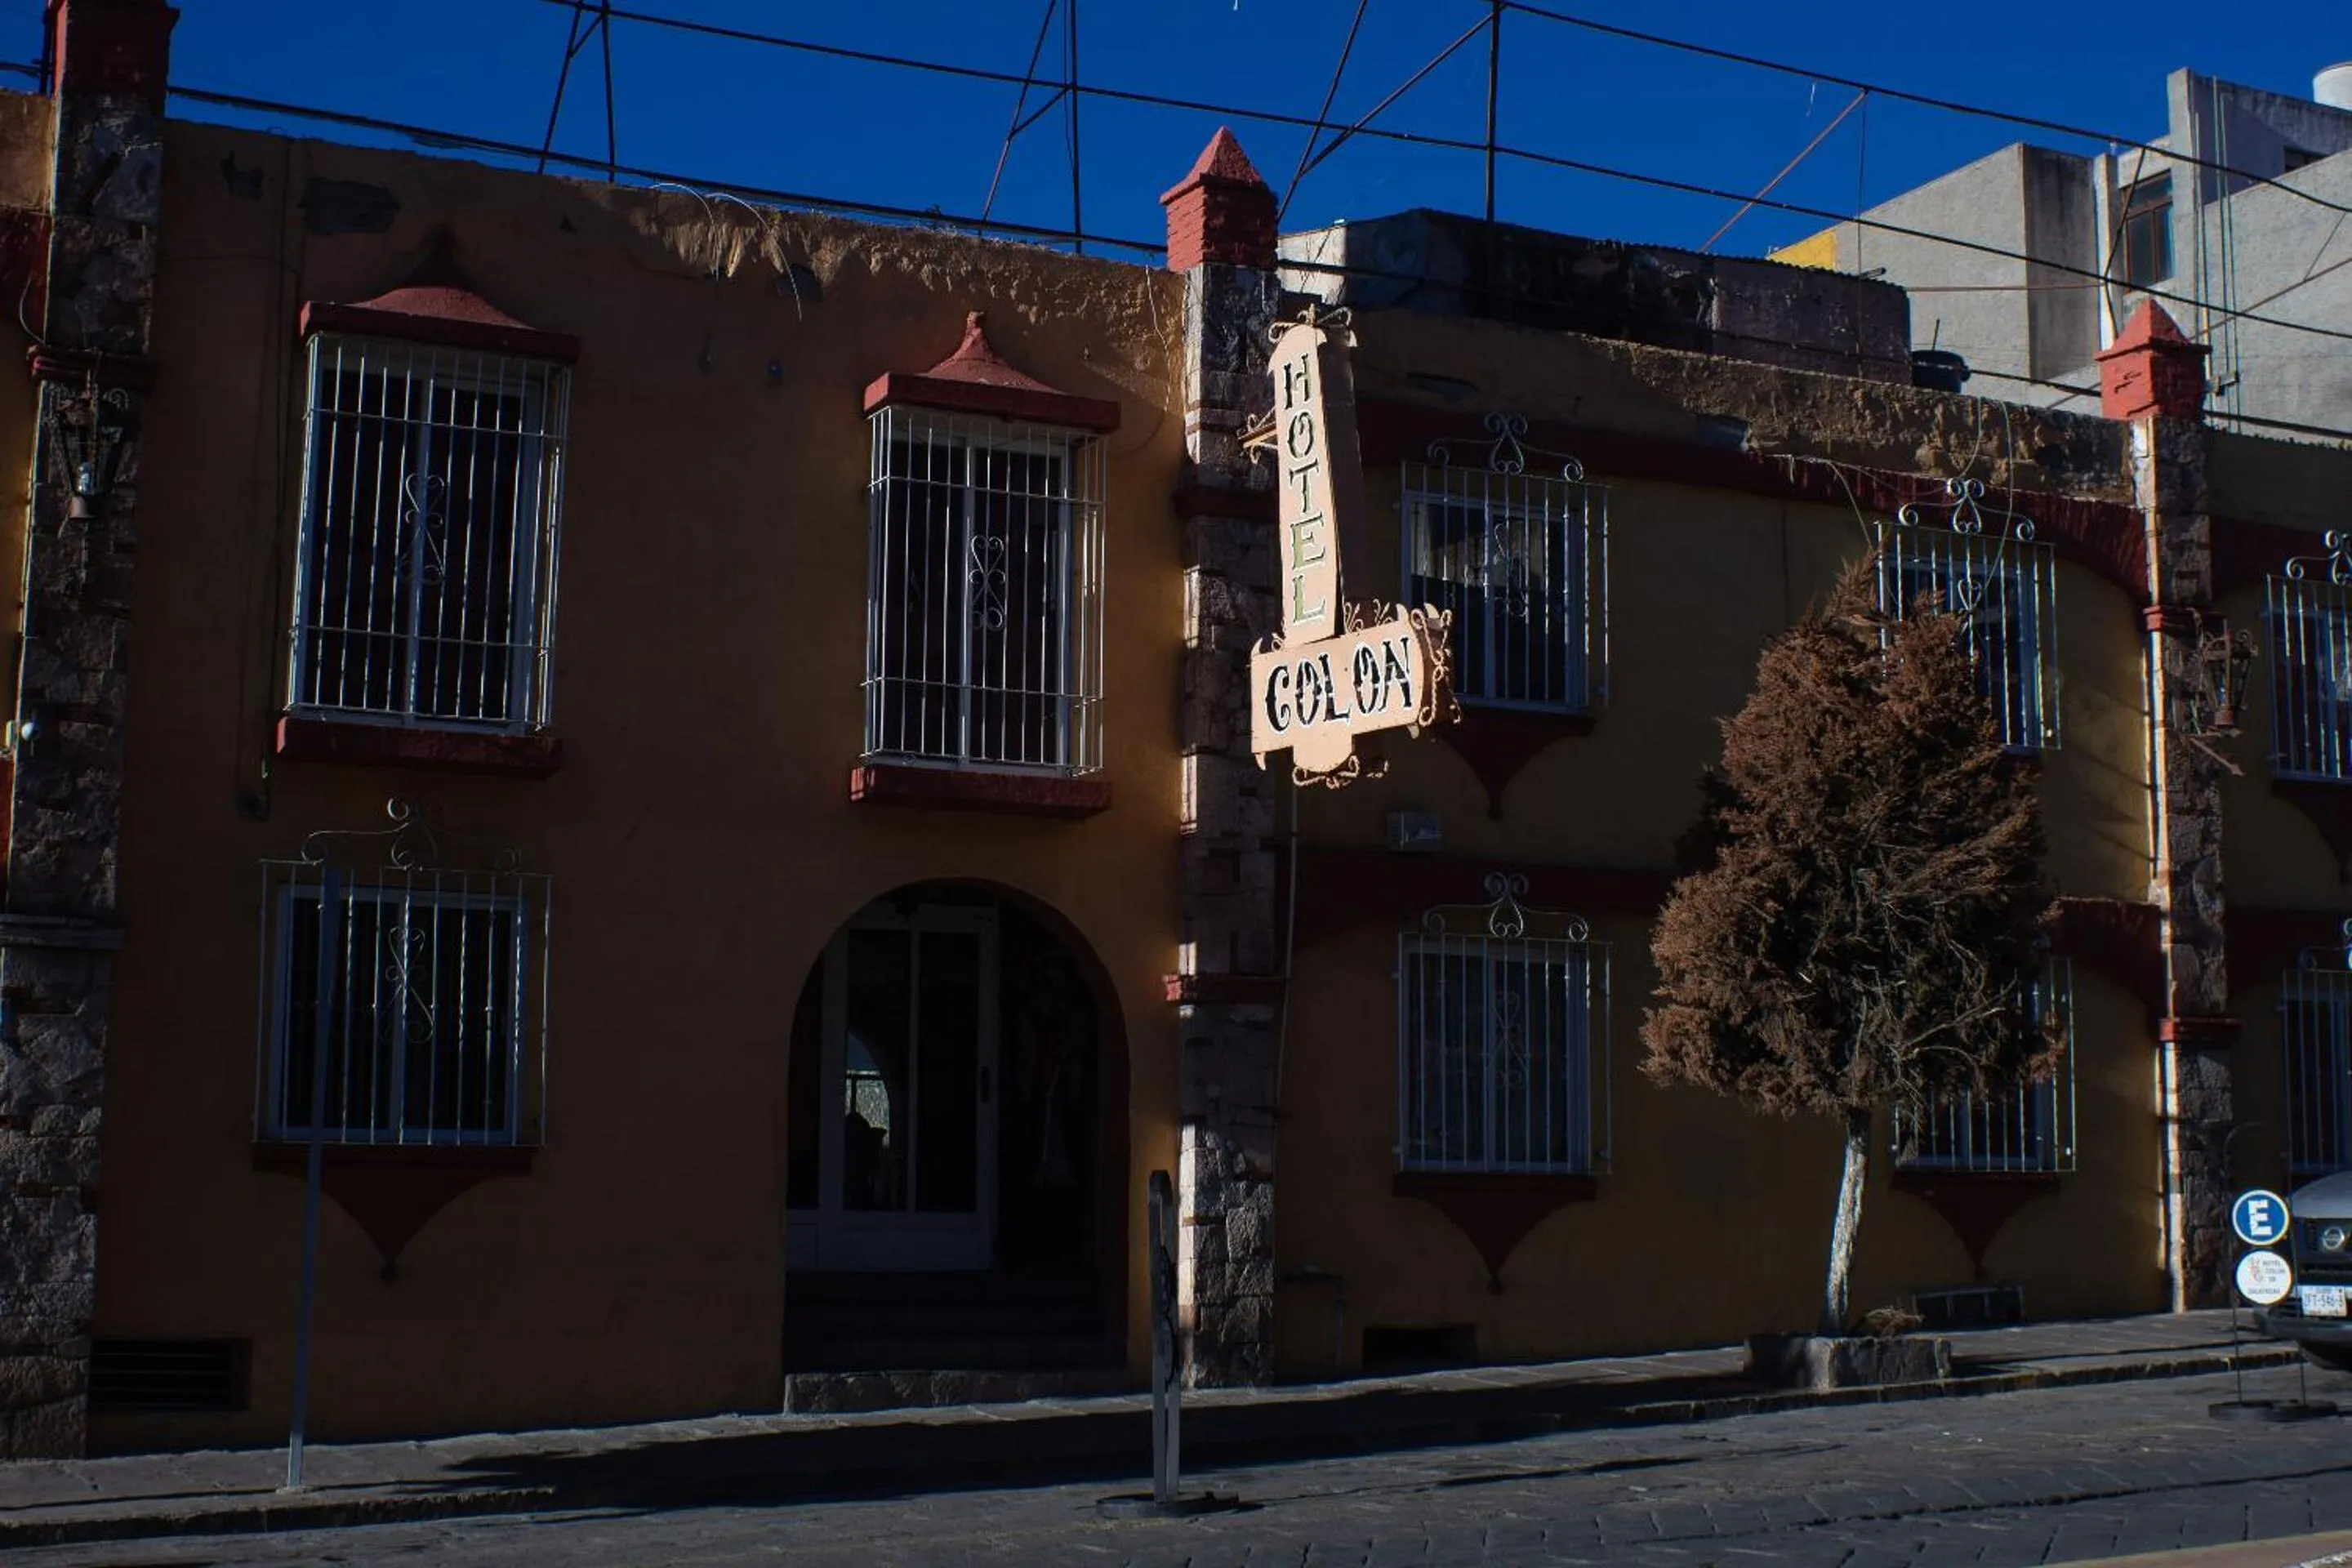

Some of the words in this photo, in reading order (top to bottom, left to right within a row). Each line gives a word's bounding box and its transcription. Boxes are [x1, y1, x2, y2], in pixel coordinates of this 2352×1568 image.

[1283, 352, 1326, 624] HOTEL
[1264, 635, 1413, 732] COLON
[2247, 1199, 2273, 1236] E
